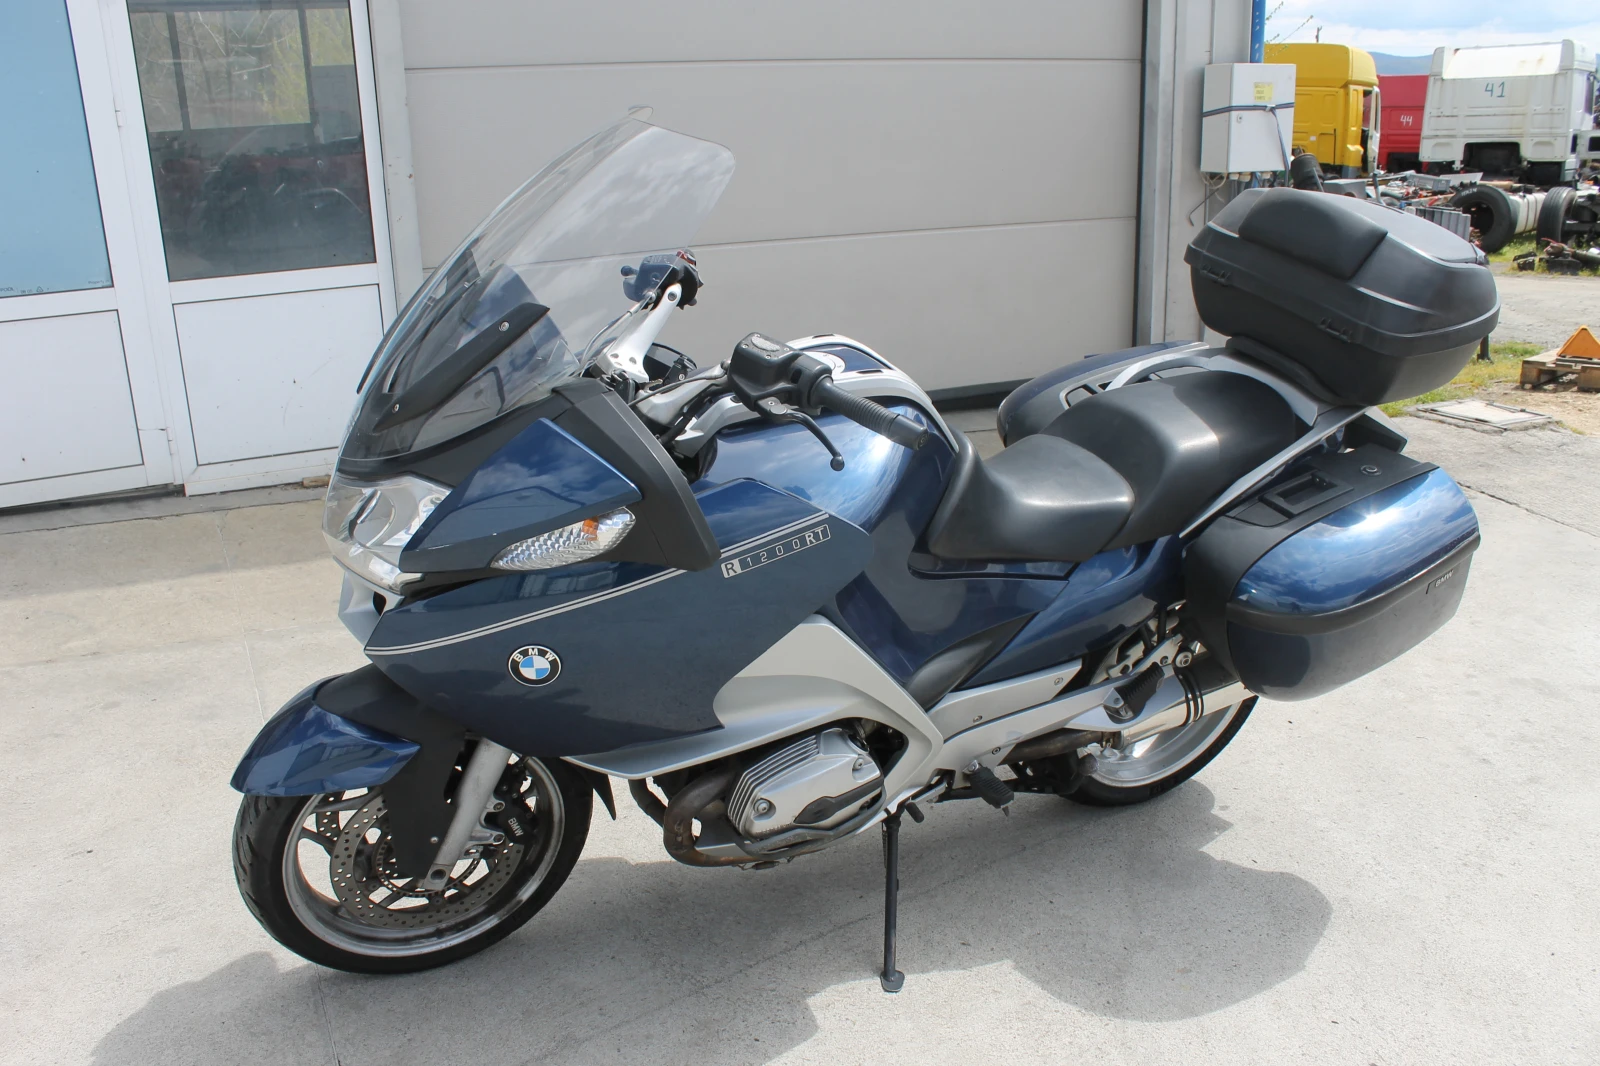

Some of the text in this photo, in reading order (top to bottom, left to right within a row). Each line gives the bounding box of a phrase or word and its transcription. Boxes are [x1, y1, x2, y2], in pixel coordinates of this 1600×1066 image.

[1484, 81, 1505, 98] 41
[1400, 115, 1413, 127] 44
[1435, 570, 1454, 587] BMW
[512, 647, 557, 662] BMW
[508, 817, 524, 836] BMW
